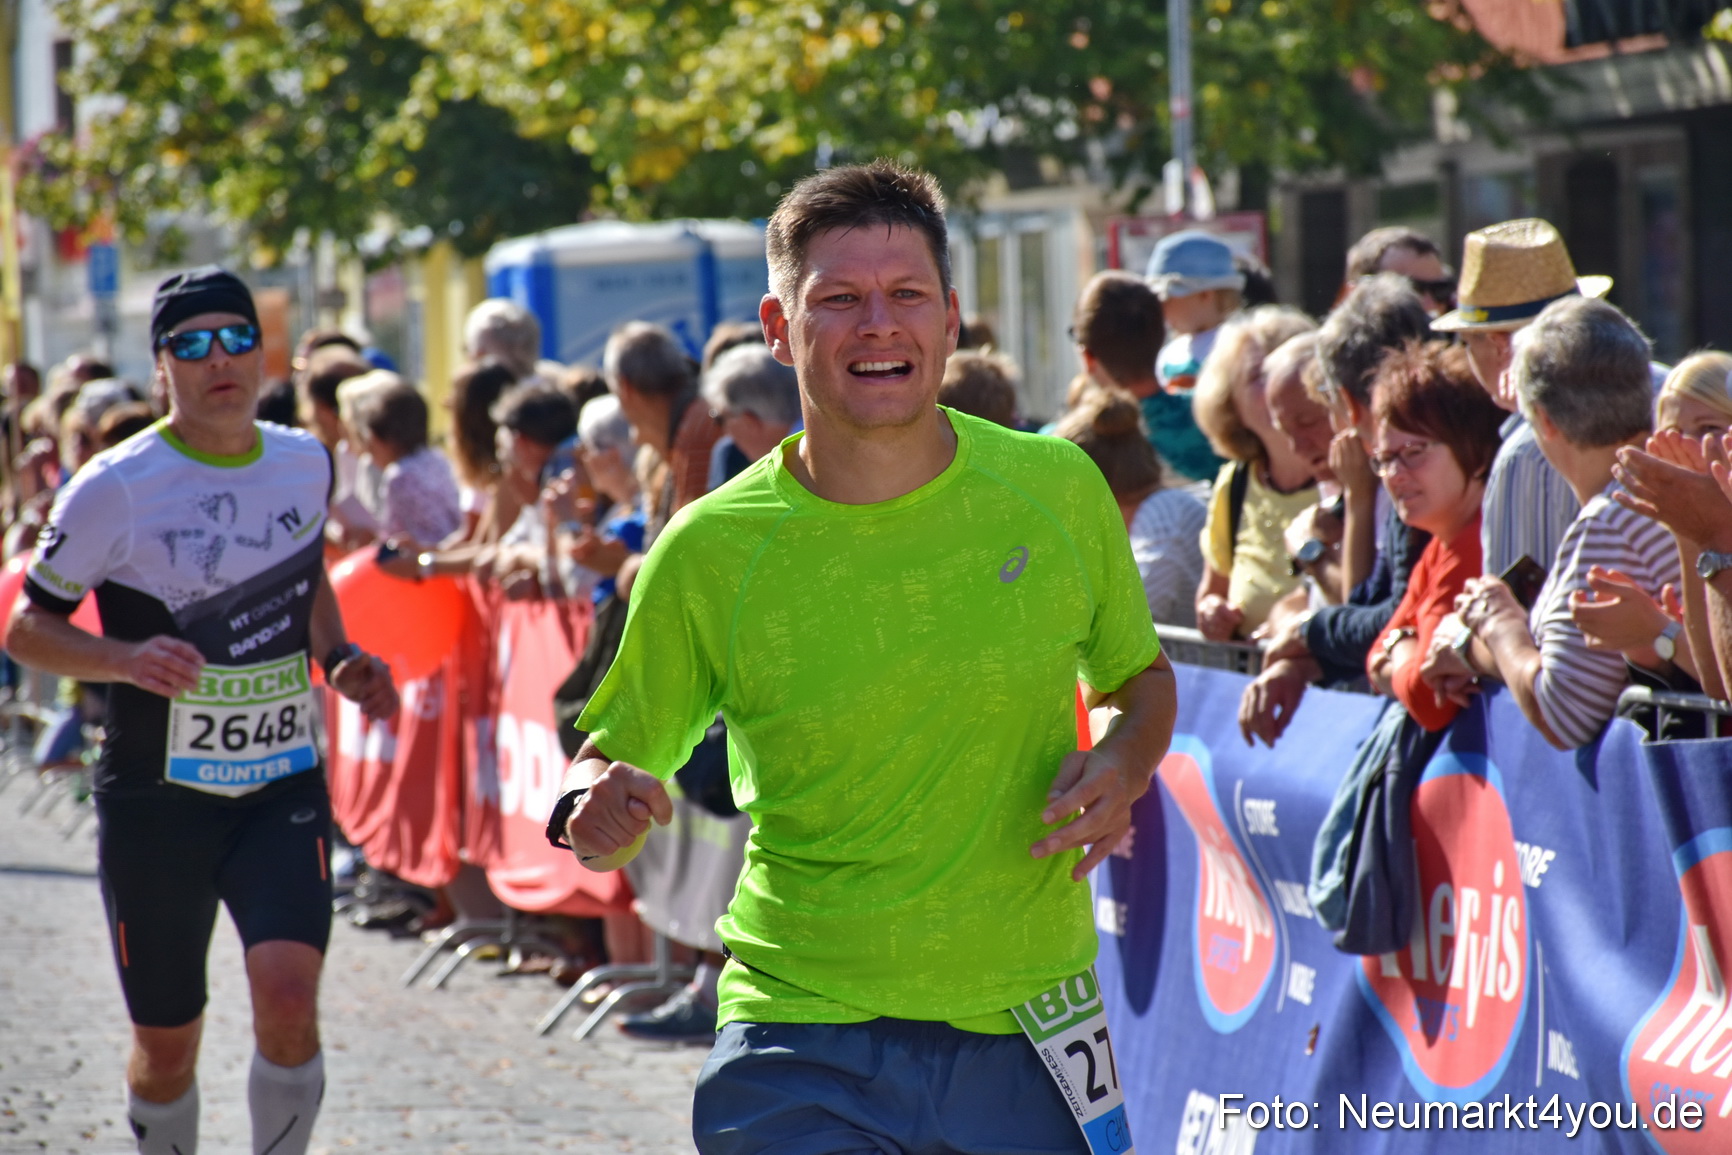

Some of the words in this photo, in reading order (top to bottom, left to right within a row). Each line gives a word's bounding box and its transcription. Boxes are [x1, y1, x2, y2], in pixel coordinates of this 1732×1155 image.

[277, 506, 302, 533] TV
[196, 668, 297, 700] BOCK
[189, 704, 297, 753] 2648
[198, 757, 292, 783] GÜNTER
